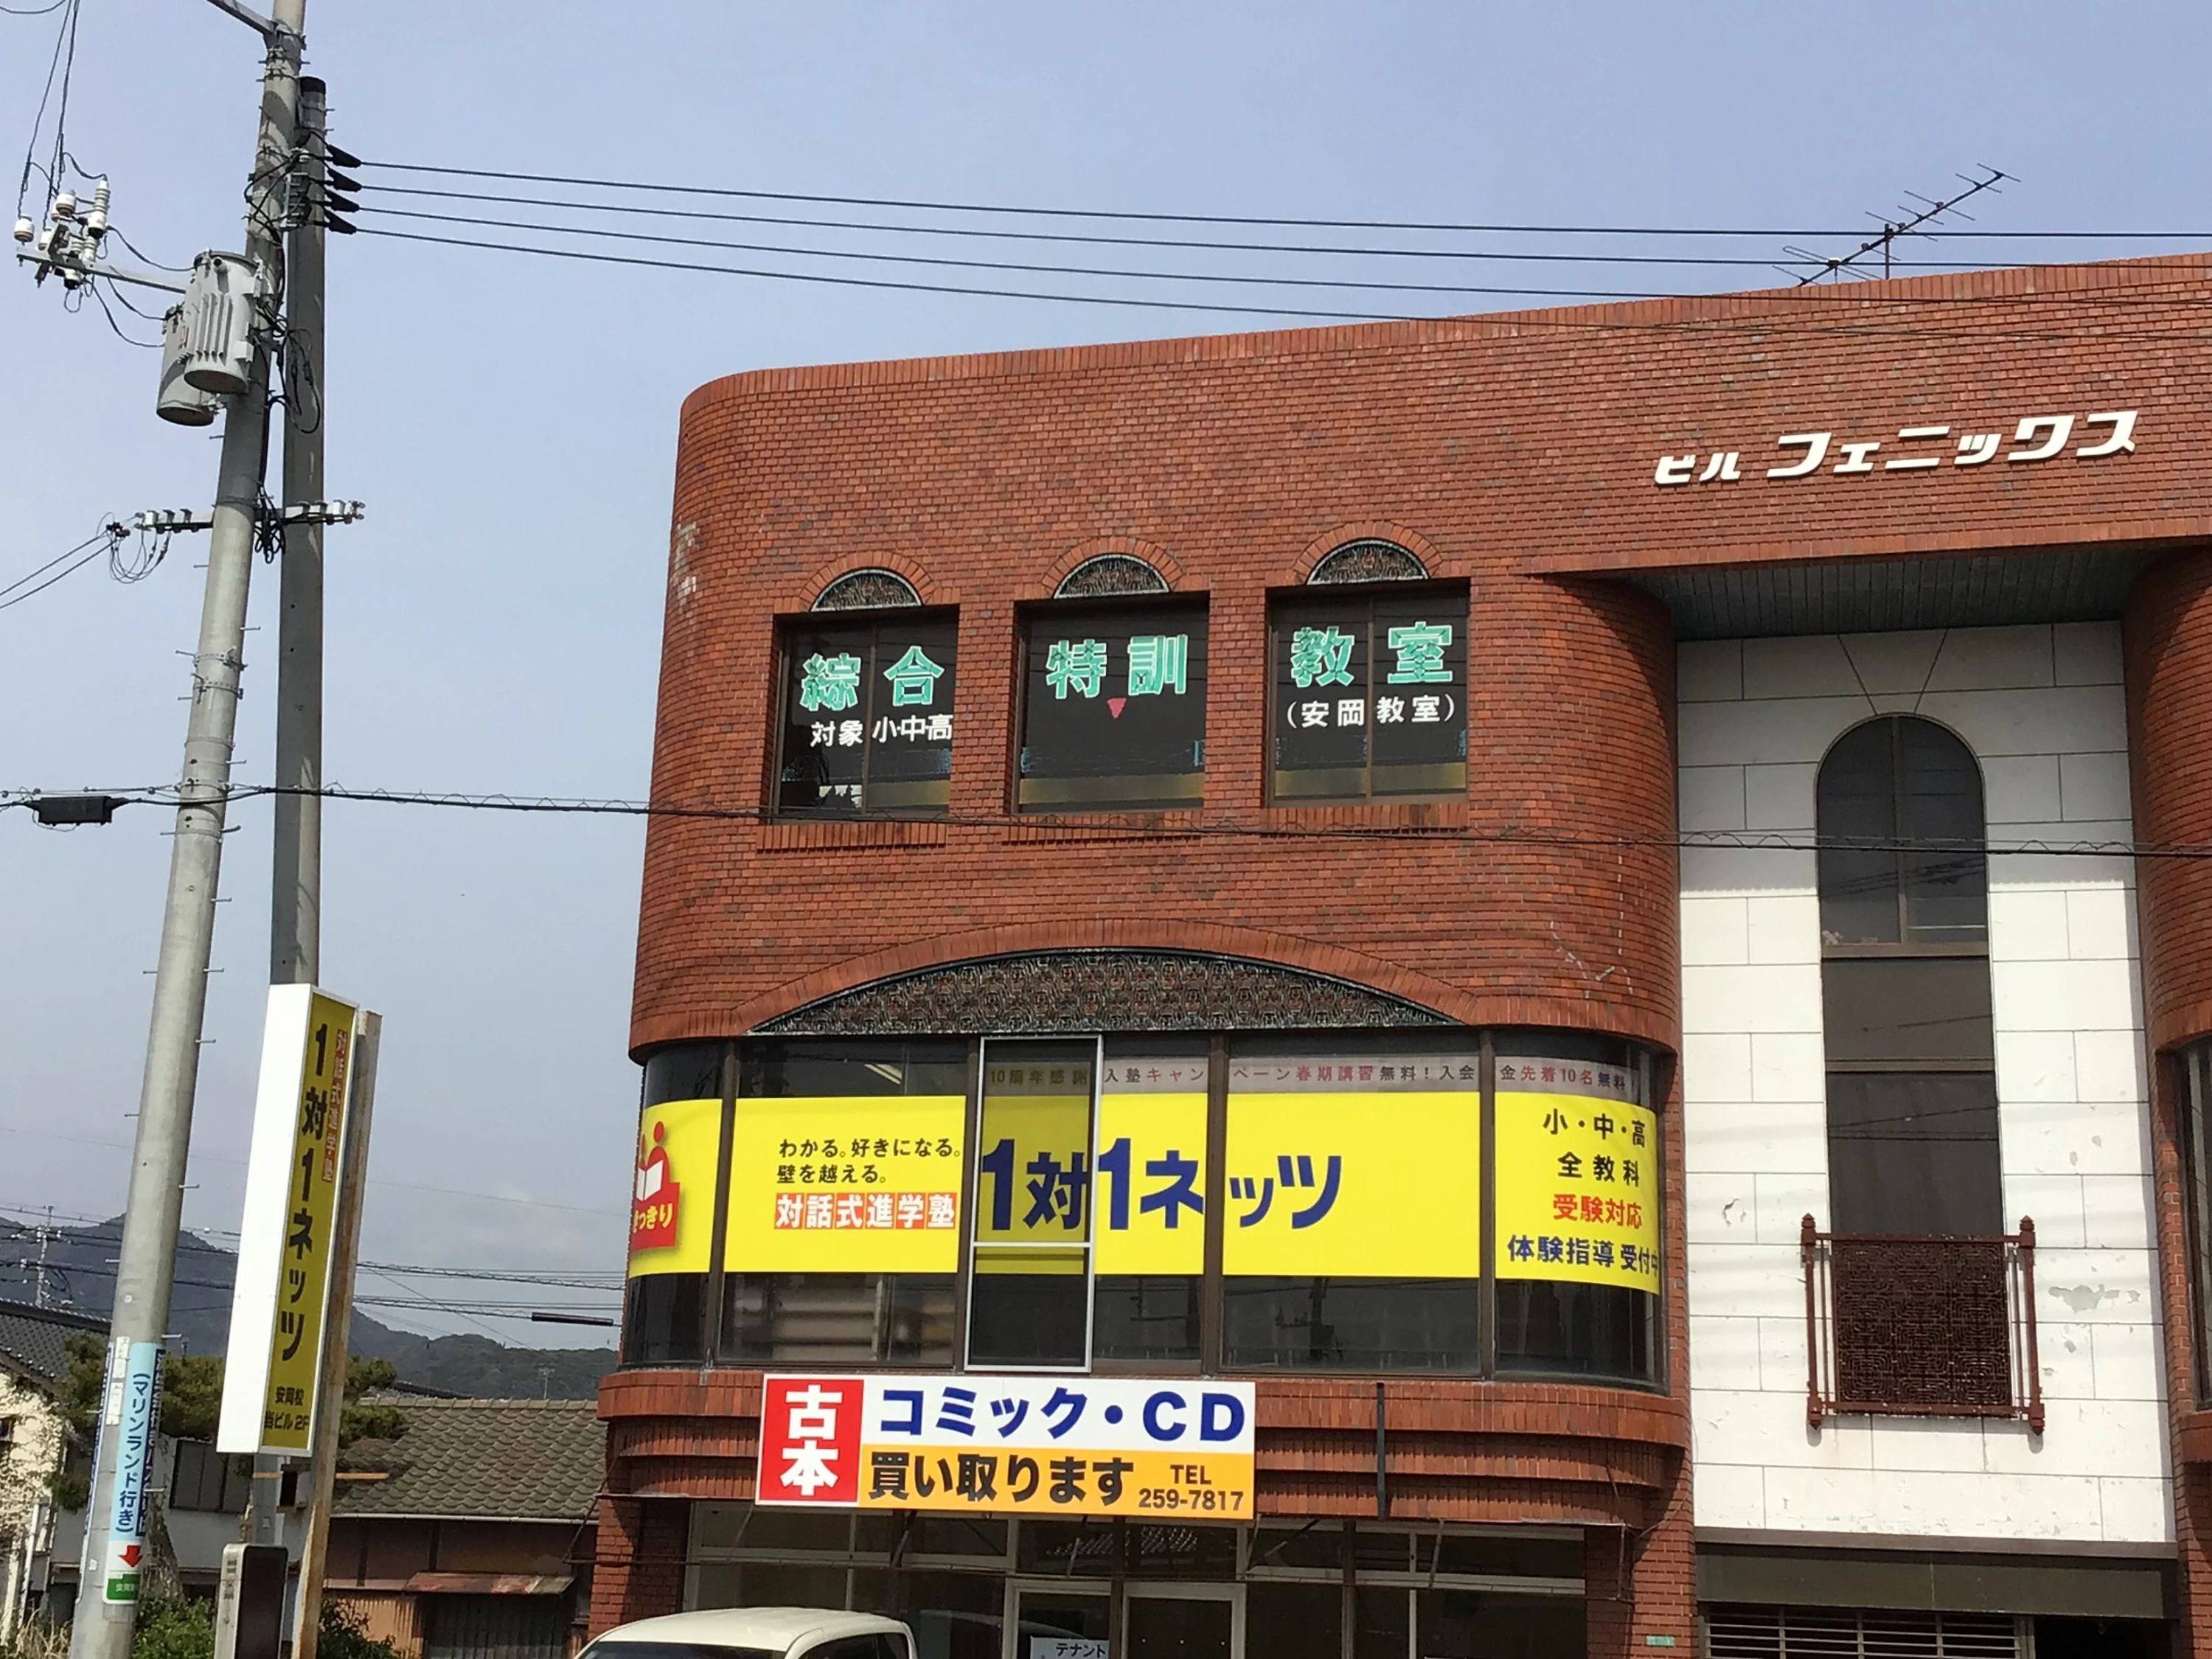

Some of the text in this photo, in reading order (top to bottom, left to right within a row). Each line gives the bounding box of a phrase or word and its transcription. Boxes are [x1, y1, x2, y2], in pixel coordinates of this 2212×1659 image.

[1655, 410, 2139, 484] ビル フェニックス
[1287, 693, 1455, 729] （安岡教室）
[810, 720, 863, 747] 対象
[776, 1164, 886, 1184] 壁を越える。
[1557, 1151, 1640, 1187] 全教科
[774, 1193, 956, 1229] 対話式進学塾
[1553, 1193, 1643, 1230] 受験対応
[779, 1384, 844, 1497] 古本
[868, 1451, 1134, 1506] 買い取ります
[1170, 1464, 1212, 1485] TEL
[1138, 1487, 1244, 1512] 259-7817
[1055, 1642, 1107, 1659] テナント
